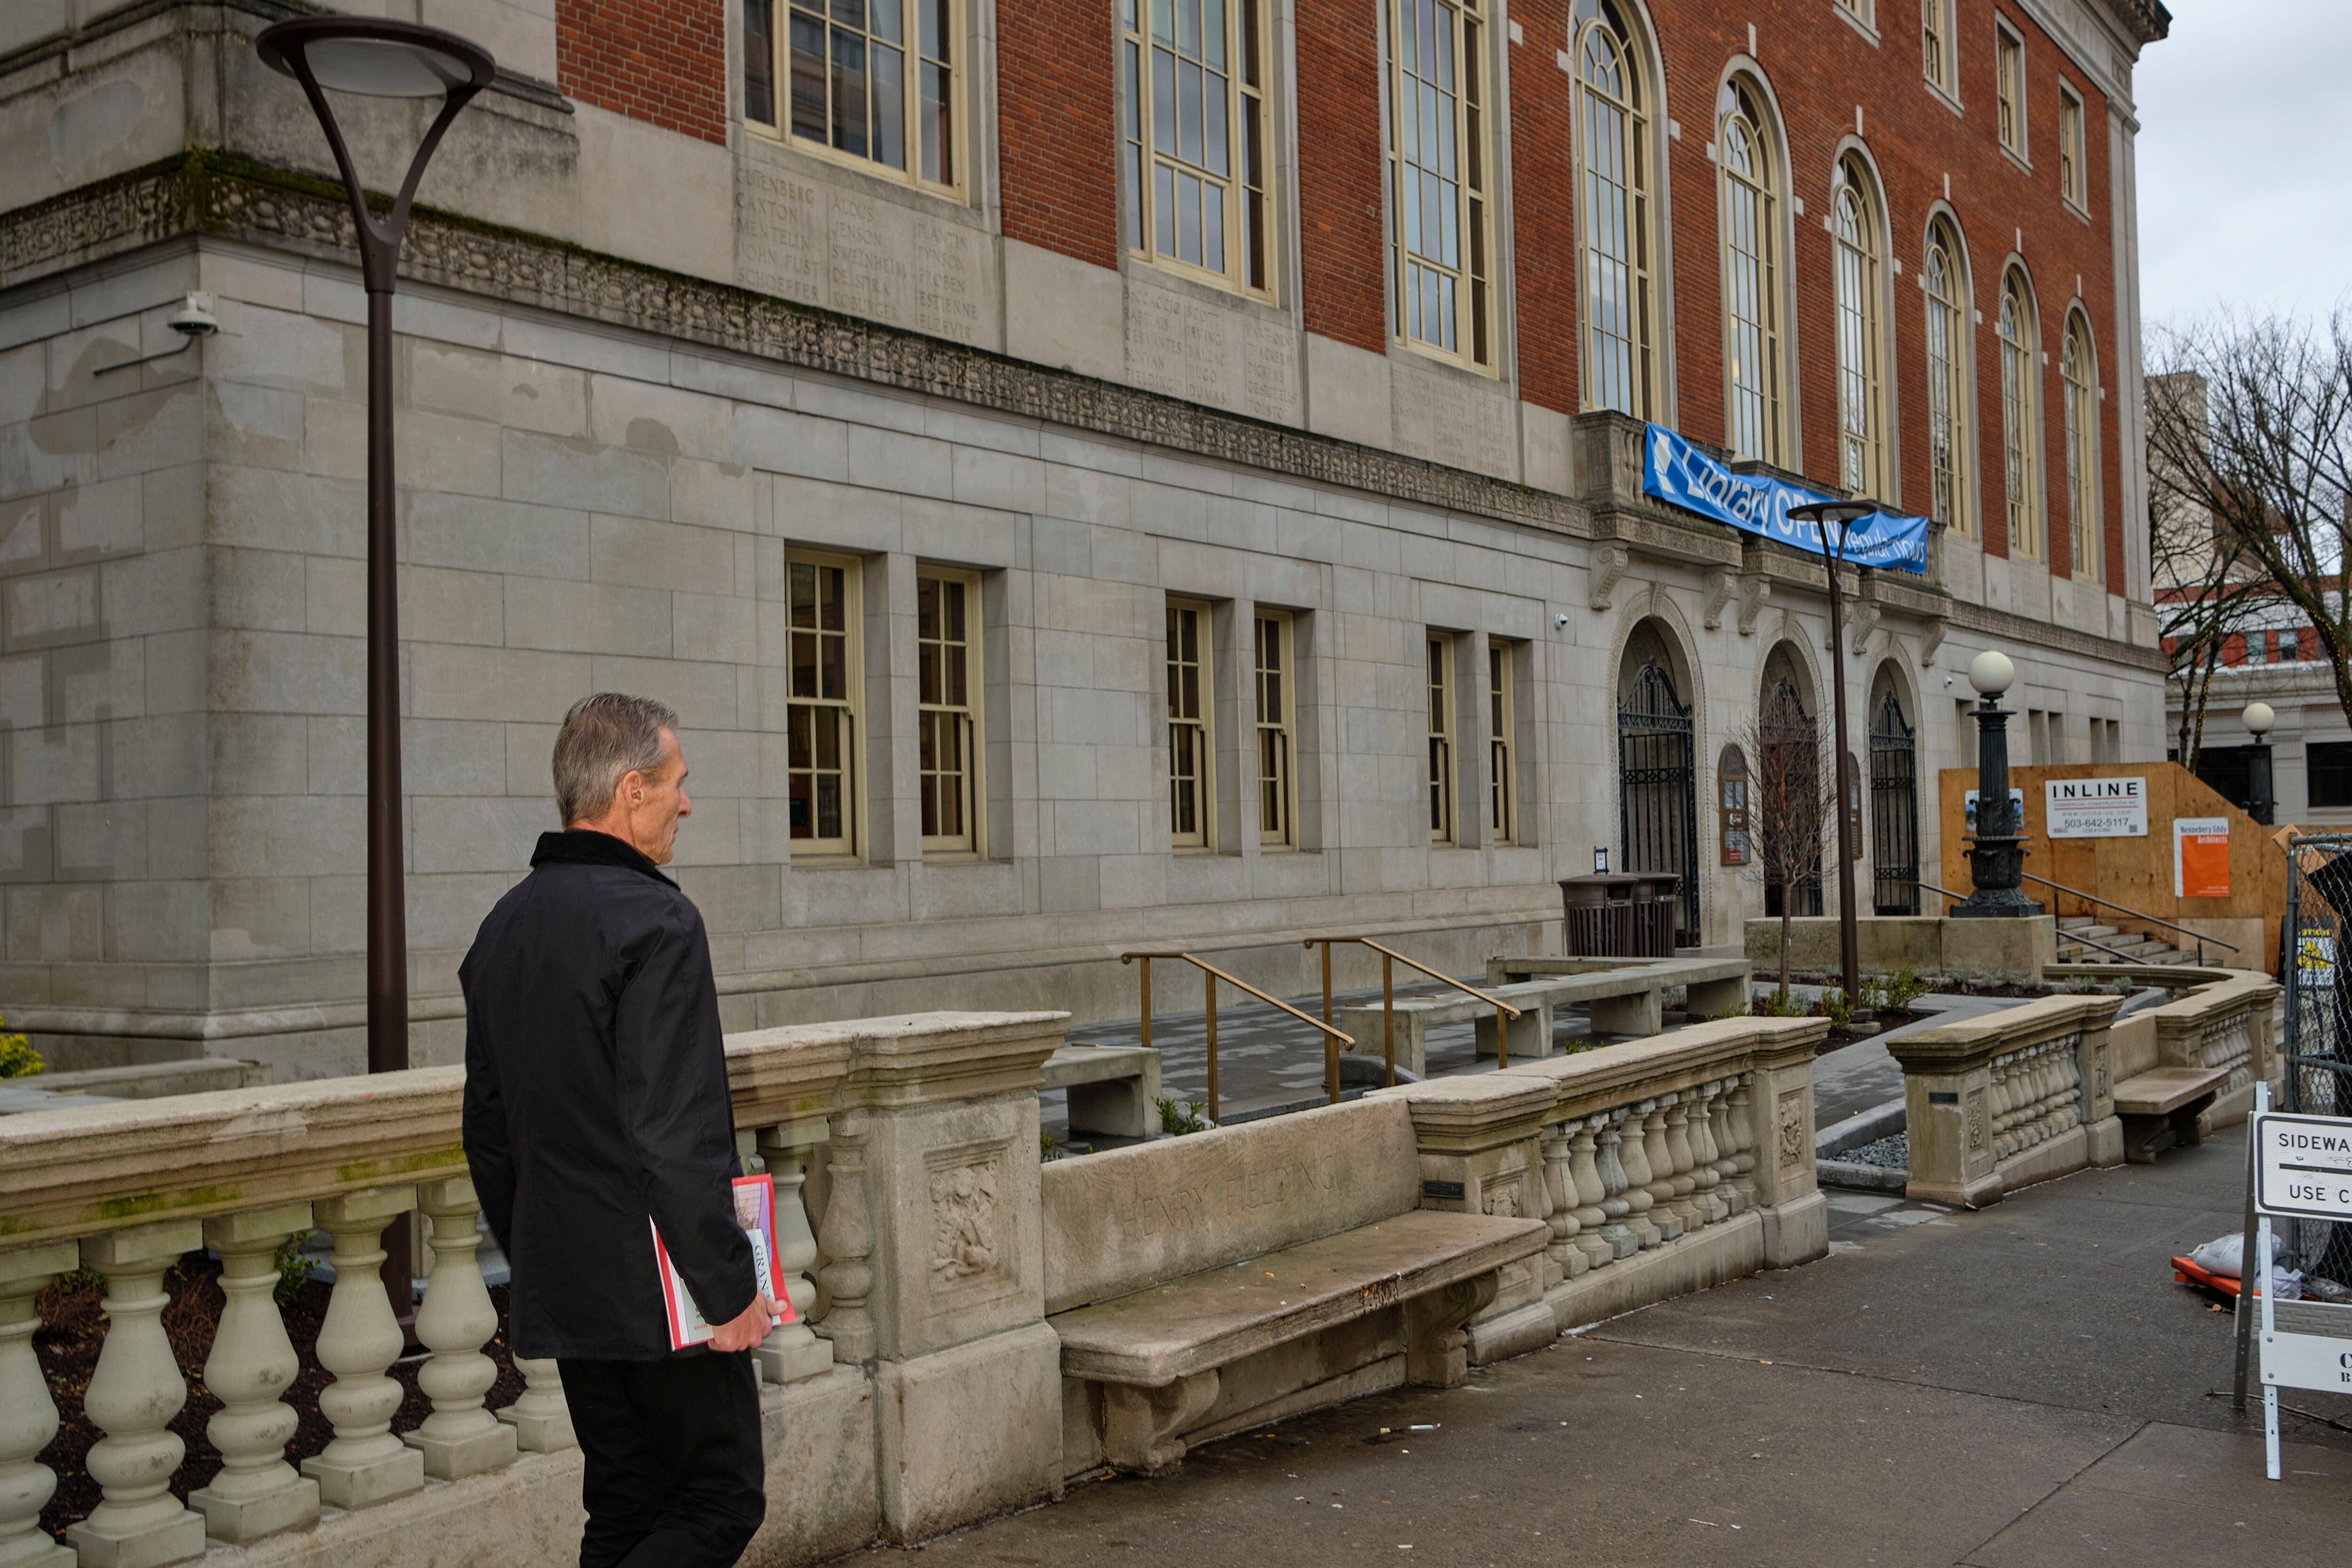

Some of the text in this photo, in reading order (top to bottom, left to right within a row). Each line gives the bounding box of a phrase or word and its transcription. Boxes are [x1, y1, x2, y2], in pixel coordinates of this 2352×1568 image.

[736, 168, 814, 205] GUTENBERG
[736, 192, 798, 224] CAXTON
[832, 198, 874, 222] ALDUS
[832, 221, 881, 246] JENSON
[918, 223, 968, 251] PLANTIN
[786, 254, 820, 277] FUST
[918, 245, 964, 271] PYNSON
[738, 267, 819, 301] SCHOEFFER
[833, 266, 848, 286] DE
[919, 268, 966, 293] FROBEN
[833, 291, 898, 321] KOBURGER
[920, 291, 978, 320] ESTIENNE
[1187, 305, 1220, 327] SCOTT
[920, 313, 971, 340] ELZEVIR
[1188, 325, 1221, 347] IRVING
[1188, 345, 1226, 367] BALZAC
[1125, 367, 1173, 392] FIELDING
[1189, 364, 1217, 383] HUGO
[1189, 384, 1226, 404] DUMAS
[1683, 447, 1925, 563] Library OPEN regular hours
[2053, 783, 2137, 798] INLINE
[2065, 817, 2129, 828] 503-642-5117
[2213, 824, 2227, 834] Eddy
[2197, 836, 2227, 844] Architects
[2279, 1133, 2350, 1152] SIDEWA
[1121, 1155, 1335, 1241] HENRY FIELDING
[2289, 1185, 2350, 1203] USE C
[2341, 1372, 2352, 1382] B
